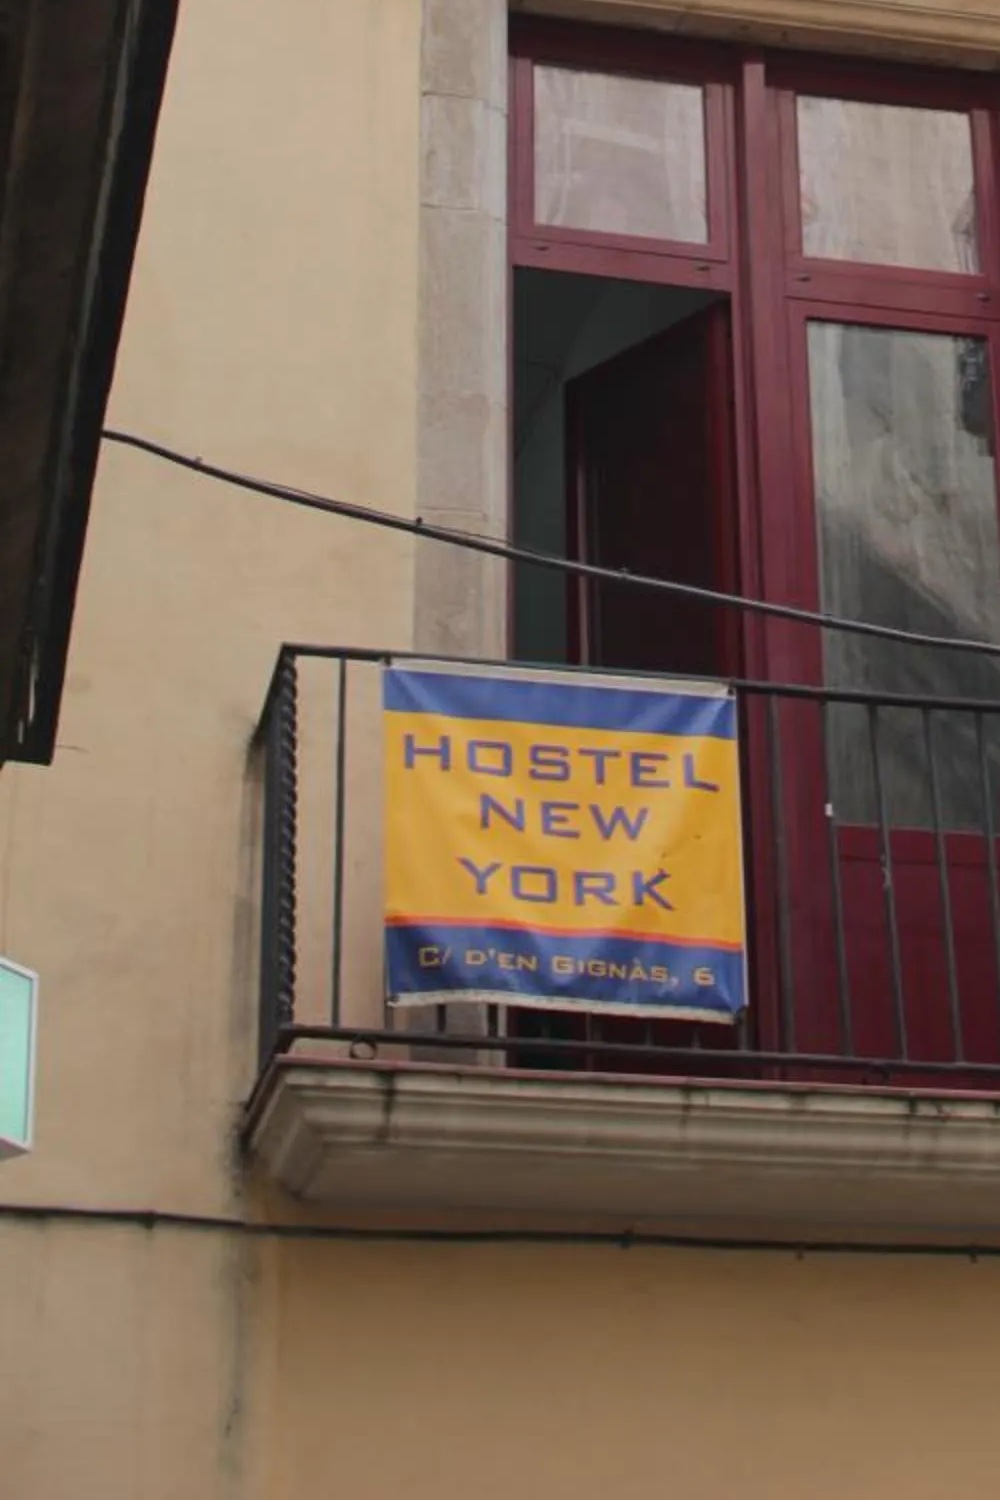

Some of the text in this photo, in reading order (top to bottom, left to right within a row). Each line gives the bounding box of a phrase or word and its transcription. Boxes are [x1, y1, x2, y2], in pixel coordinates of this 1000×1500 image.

[403, 733, 720, 793] HOSTEL
[479, 793, 650, 842] NEW
[456, 856, 675, 912] YORK
[418, 946, 452, 968] C/
[691, 967, 716, 987] 6
